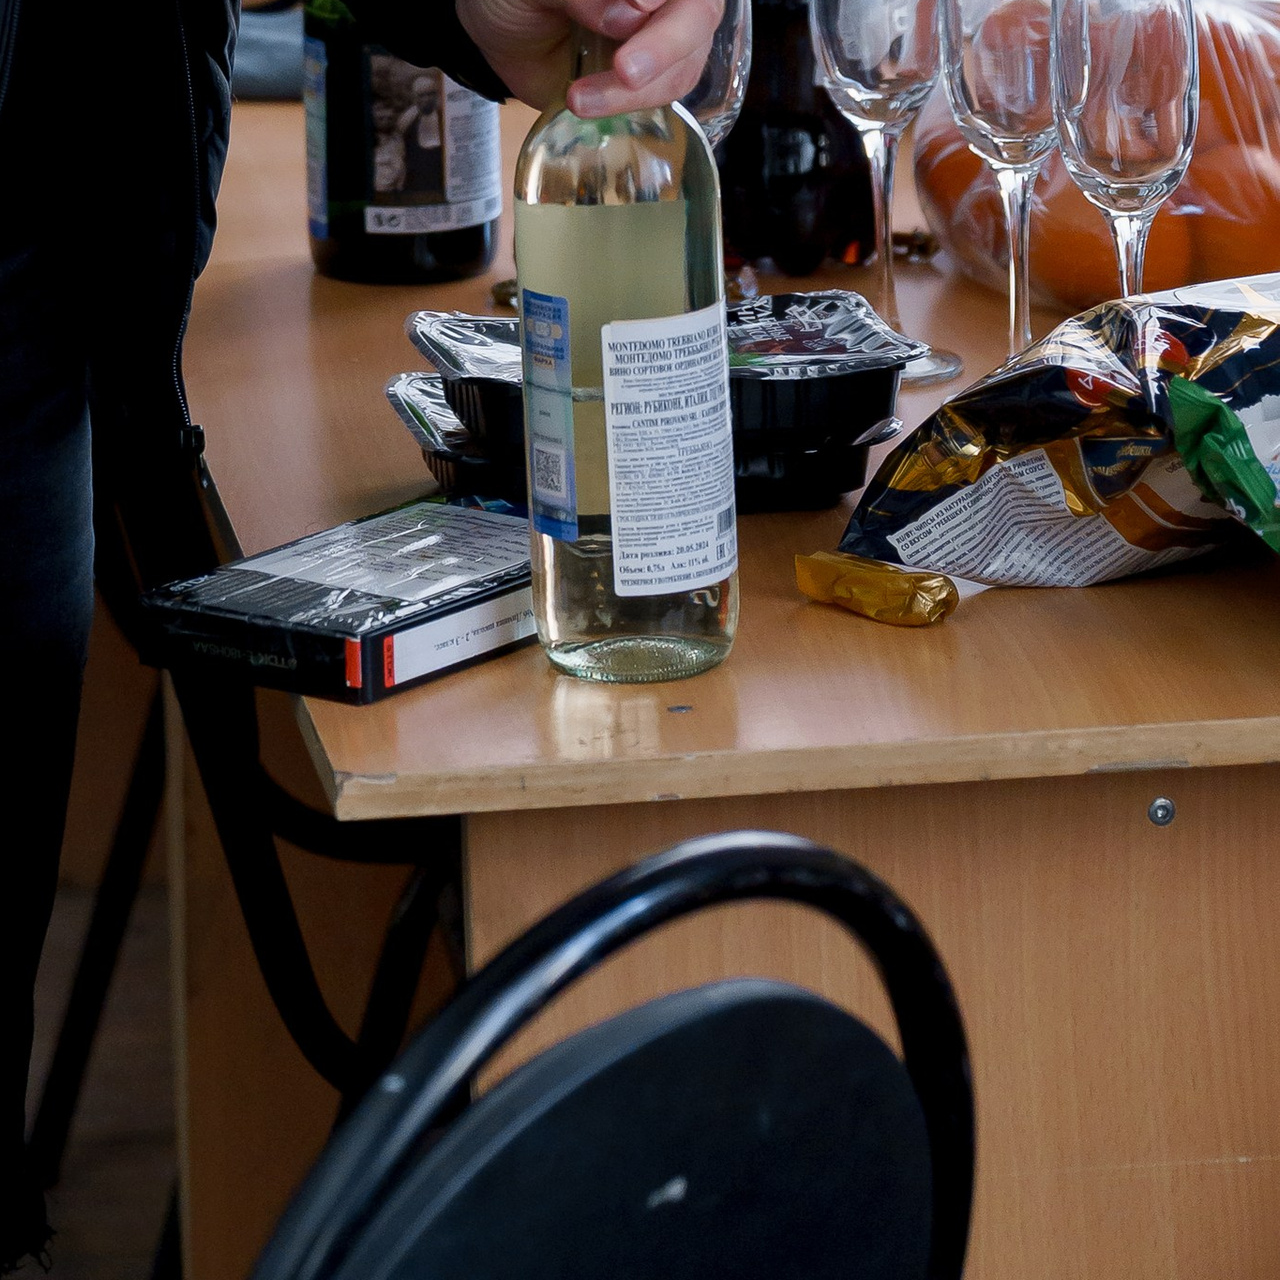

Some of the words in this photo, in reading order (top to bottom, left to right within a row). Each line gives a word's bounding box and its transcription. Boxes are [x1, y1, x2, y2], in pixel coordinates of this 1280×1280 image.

[608, 340, 665, 352] MONTEDOMO
[615, 350, 672, 364] МОНТЕДОМО
[609, 367, 631, 377] ВИНО
[633, 363, 673, 375] СОРТОВОЕ
[611, 402, 643, 416] РЕГИОН:
[914, 516, 935, 532] ЧИПСЫ
[934, 509, 944, 519] ИЗ
[901, 544, 910, 552] СО
[909, 528, 933, 546] ВКУСОМ
[619, 551, 639, 561] Дата
[640, 548, 675, 560] розлива:
[619, 565, 645, 575] Объем:
